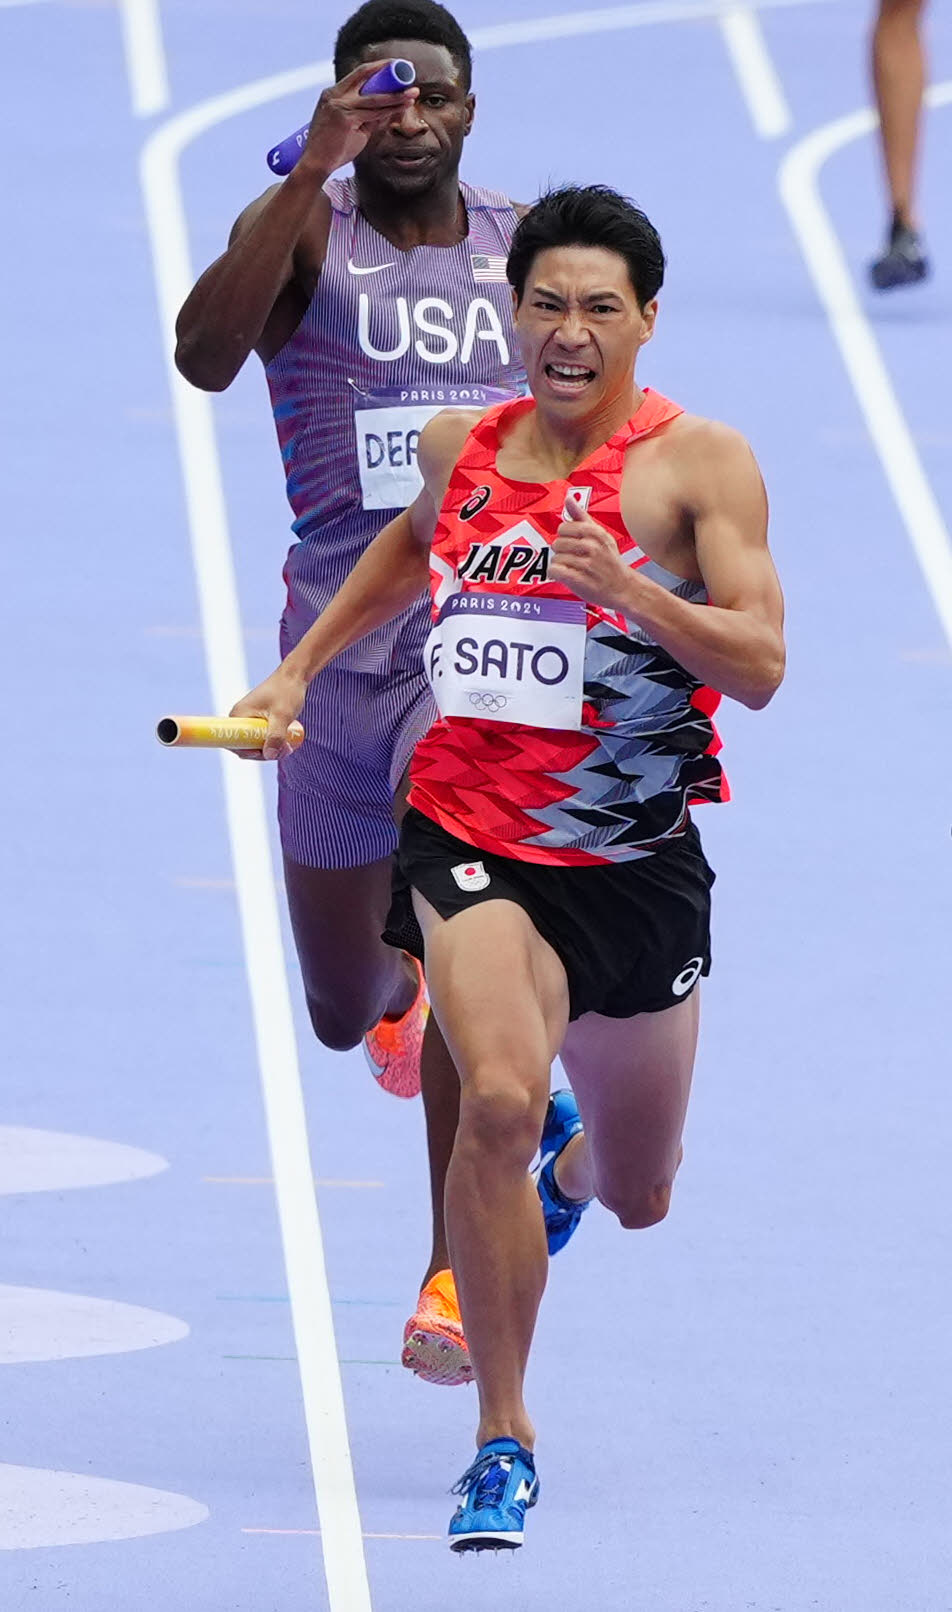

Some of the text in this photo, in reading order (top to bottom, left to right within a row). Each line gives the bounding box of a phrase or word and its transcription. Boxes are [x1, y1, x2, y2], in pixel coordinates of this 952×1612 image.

[358, 293, 510, 365] USA
[401, 390, 487, 401] PARIS 2024
[365, 429, 421, 469] DEA
[458, 542, 553, 584] JAPA
[451, 597, 541, 615] PARIS 2024
[454, 637, 569, 686] SATO
[243, 727, 267, 740] ARIS
